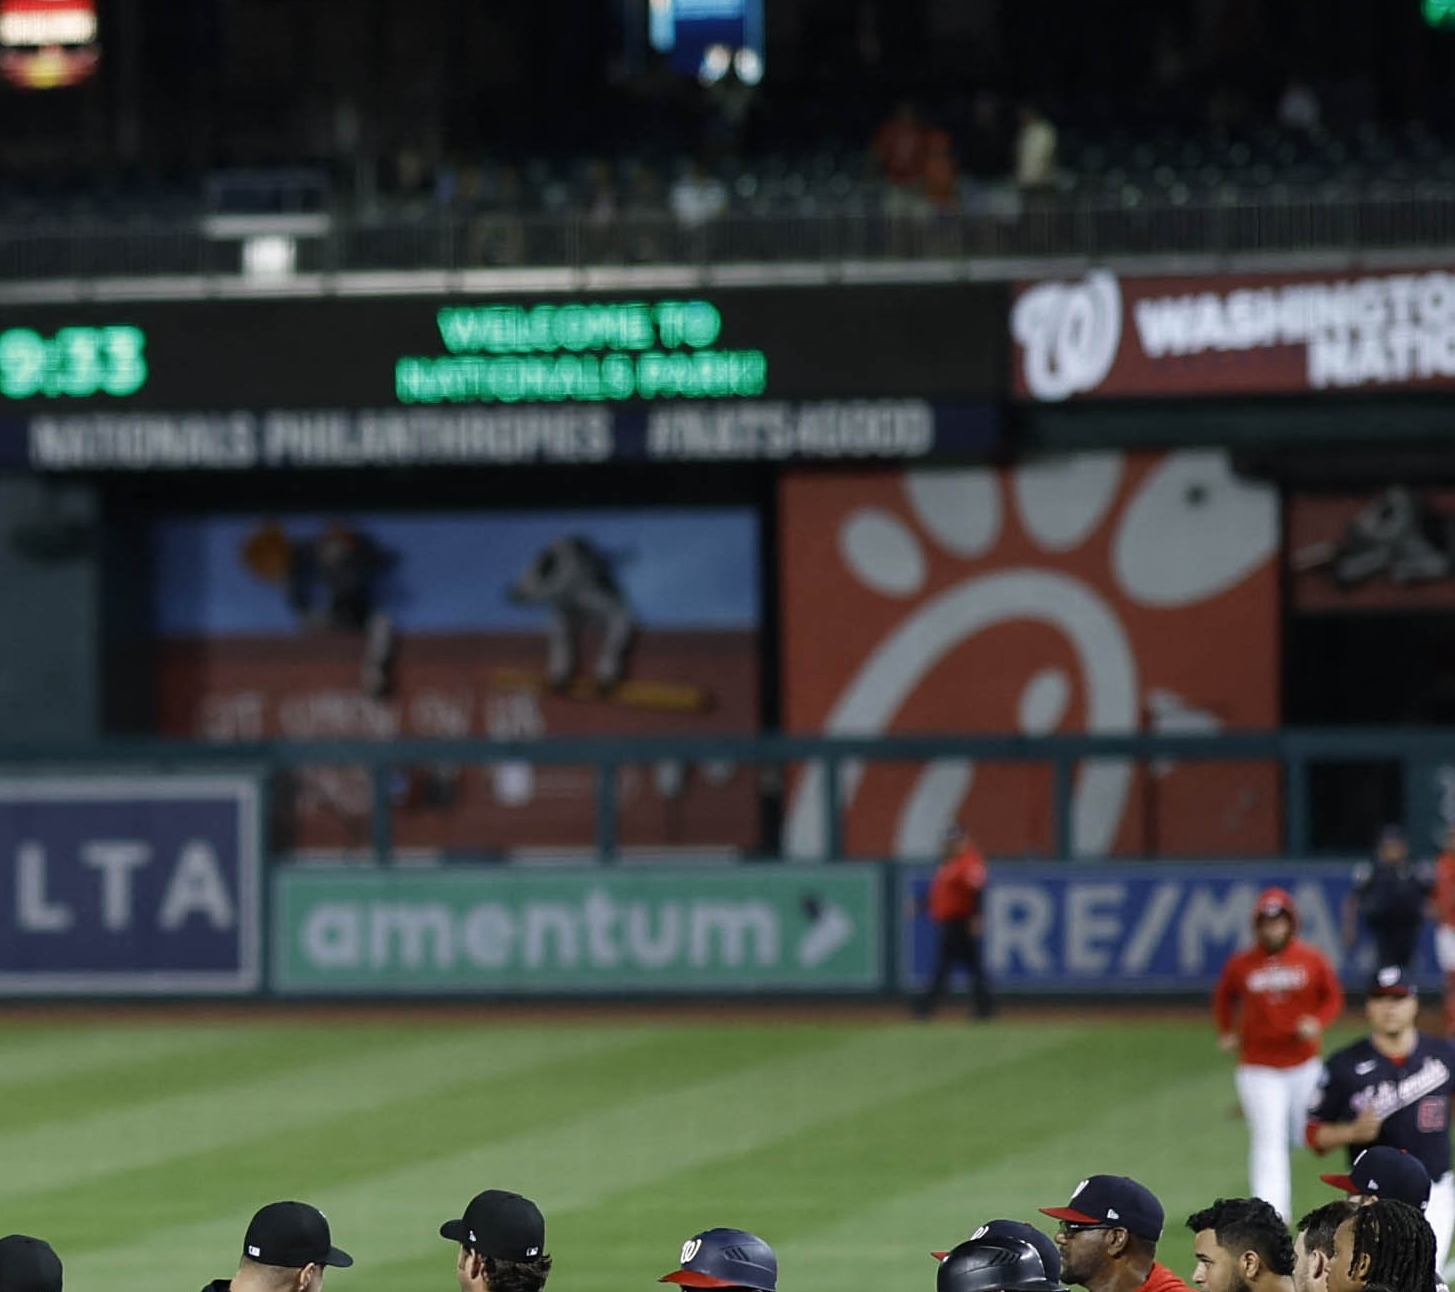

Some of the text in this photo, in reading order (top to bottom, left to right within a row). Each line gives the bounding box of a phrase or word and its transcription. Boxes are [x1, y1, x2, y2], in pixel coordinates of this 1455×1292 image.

[437, 300, 722, 353] WELCOME TO
[1011, 268, 1122, 401] W
[395, 352, 635, 403] NATIONALS
[30, 411, 260, 470] NATIONALS
[264, 407, 615, 466] PHILANTHROPIES
[300, 888, 782, 971] amentum
[984, 883, 1374, 976] RE/MA
